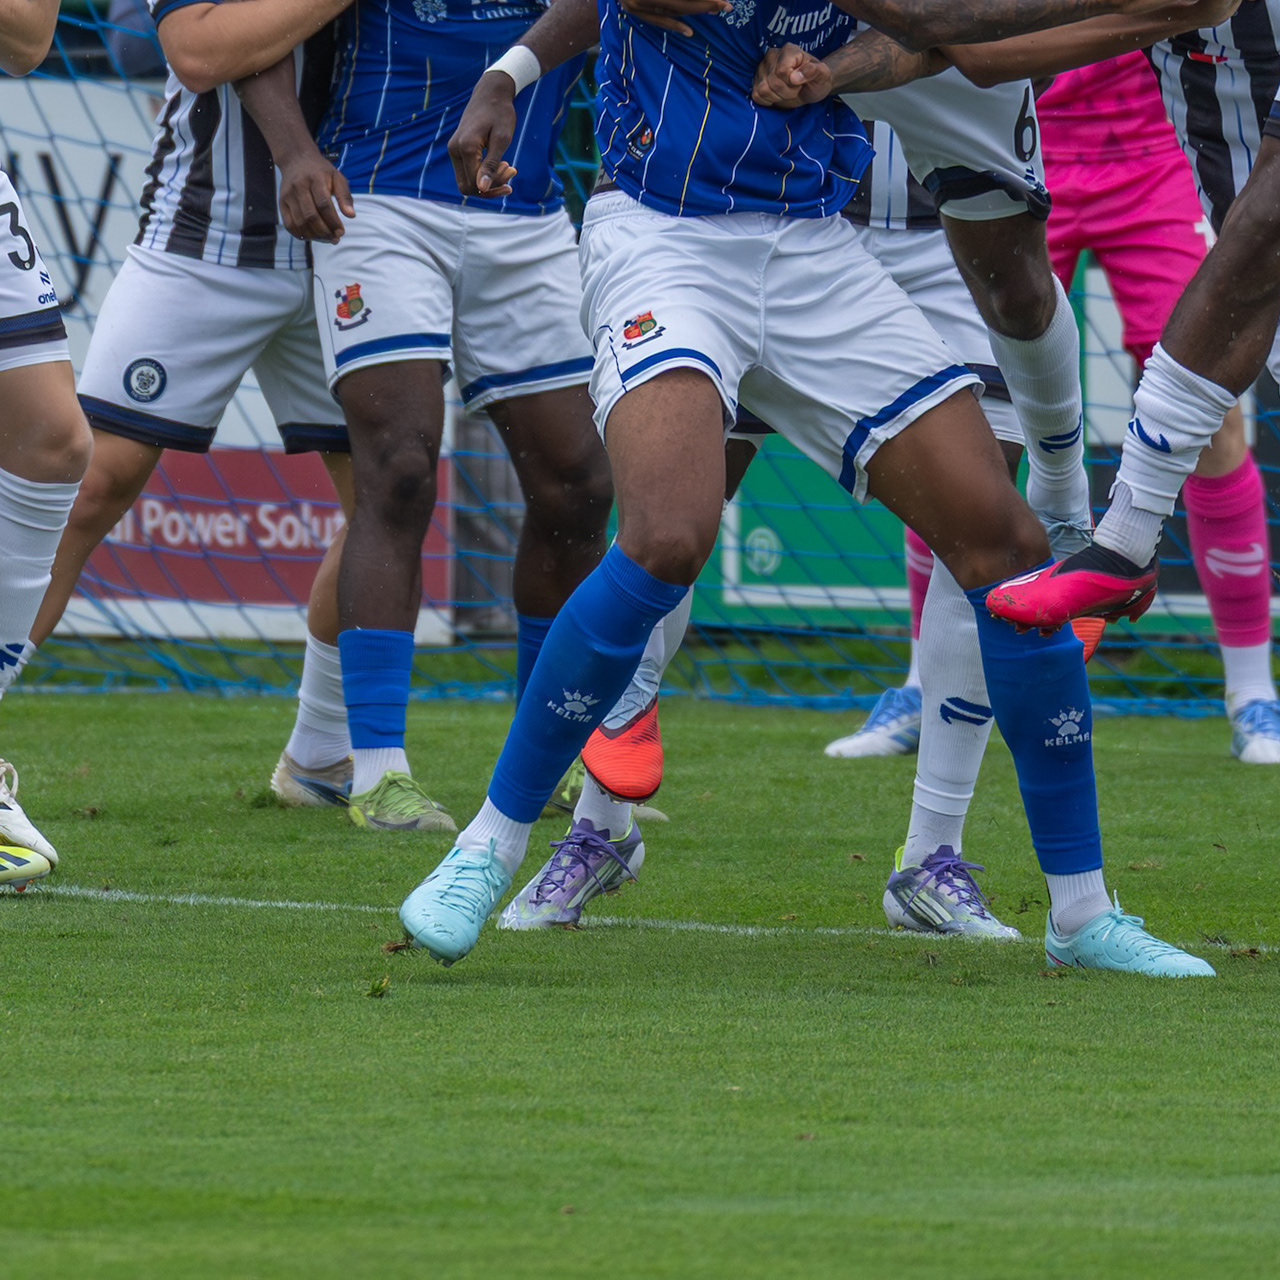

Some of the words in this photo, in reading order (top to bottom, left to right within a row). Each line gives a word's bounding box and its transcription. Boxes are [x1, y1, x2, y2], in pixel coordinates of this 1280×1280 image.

[141, 499, 249, 546] Power
[257, 503, 345, 550] Solut
[547, 700, 593, 723] KELME
[1044, 731, 1090, 747] KELME
